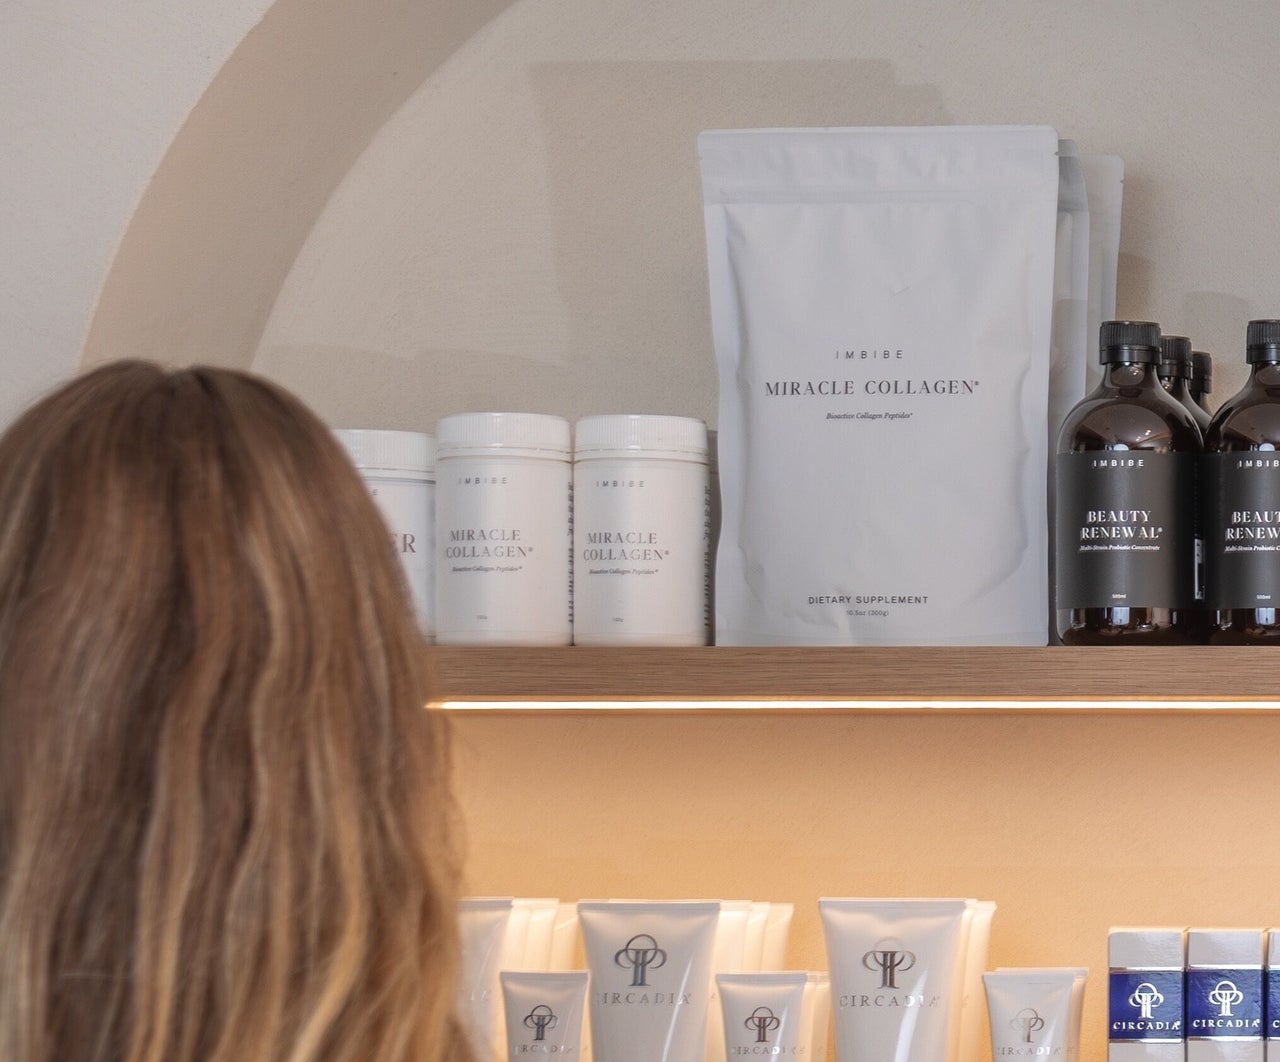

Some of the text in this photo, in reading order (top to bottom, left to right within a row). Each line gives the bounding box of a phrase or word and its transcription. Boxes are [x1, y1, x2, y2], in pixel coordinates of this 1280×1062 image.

[836, 350, 903, 359] IMBIBE
[765, 381, 855, 396] MIRACLE
[856, 412, 883, 421] Collagen
[1093, 459, 1145, 468] IMBIBE
[458, 476, 508, 485] IMBIBE
[596, 480, 645, 488] IMBIBE
[1087, 510, 1151, 524] BEAUTY
[450, 528, 521, 542] MIRACLE
[587, 532, 658, 545] MIRACLE
[808, 595, 929, 605] DIETARY SUPPLEMENT
